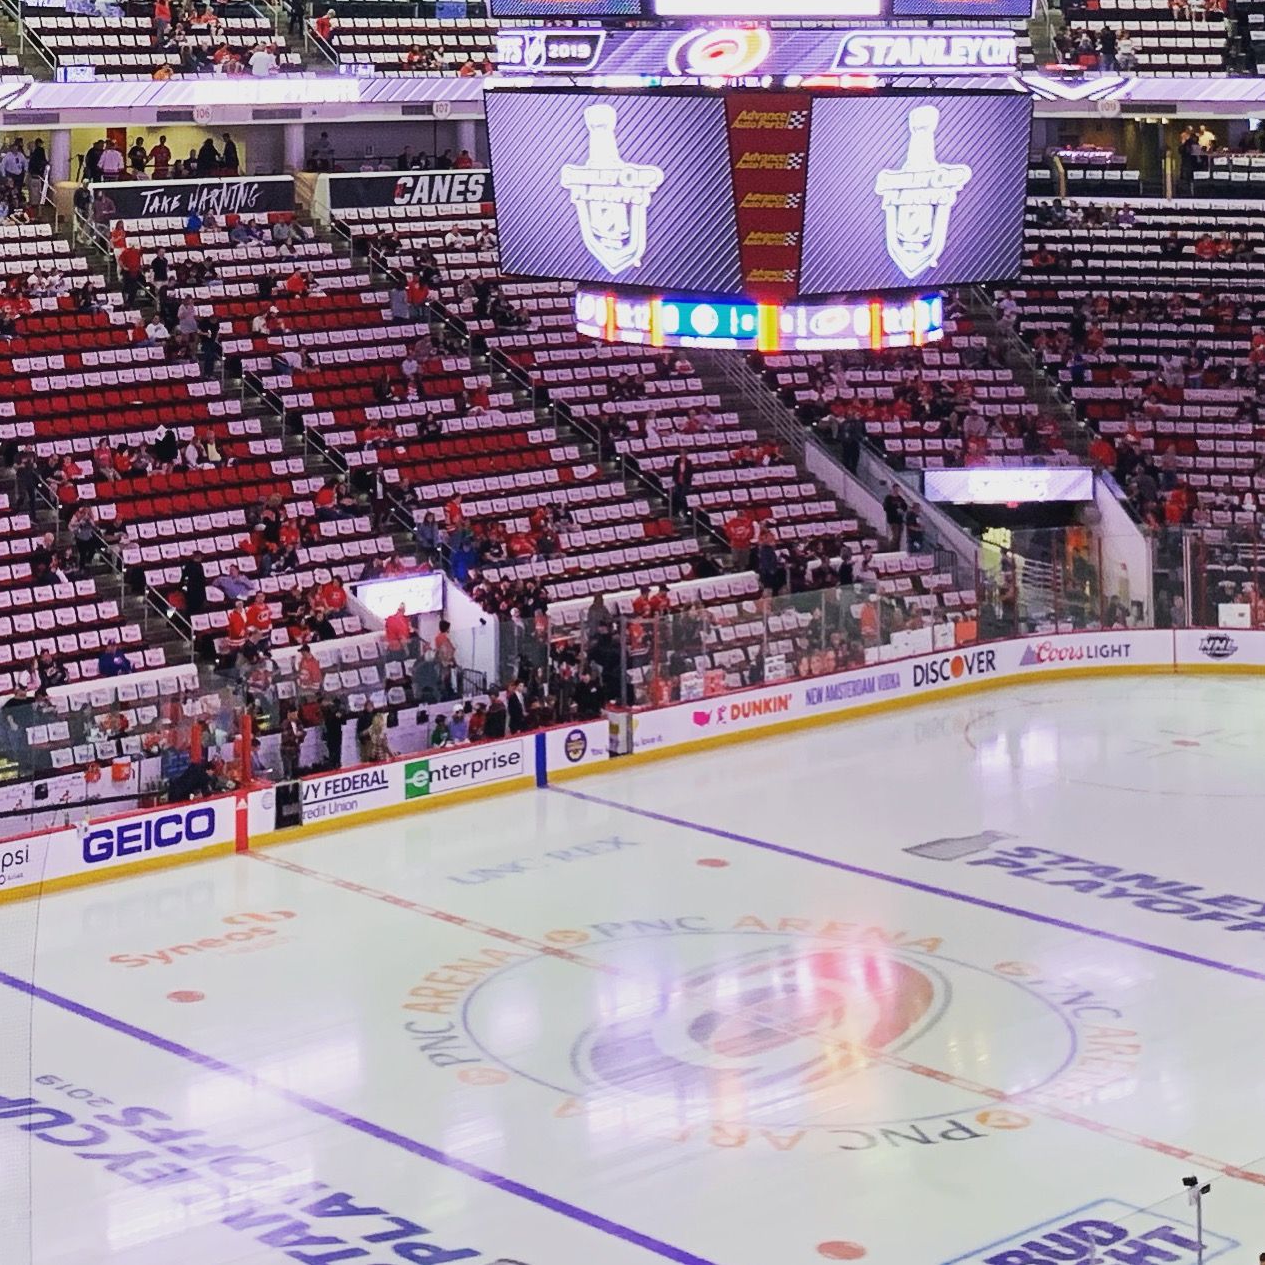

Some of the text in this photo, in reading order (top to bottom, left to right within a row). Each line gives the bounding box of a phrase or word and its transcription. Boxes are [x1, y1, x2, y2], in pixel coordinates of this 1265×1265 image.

[548, 43, 591, 59] 2019
[844, 37, 982, 67] STANLEY
[195, 108, 211, 120] 106
[435, 103, 449, 115] 107
[738, 110, 787, 121] Advance
[140, 182, 264, 217] TAKE WARNING
[394, 174, 485, 205] CANES
[1036, 641, 1131, 664] Coors LIGHT
[913, 649, 997, 688] DISCOVER
[805, 672, 901, 707] NEW AMSTERDAM VODKA
[730, 692, 793, 721] DUNKIN'
[324, 769, 389, 794] FEDERAL
[413, 749, 520, 786] enterprise
[302, 798, 358, 821] redit Union
[82, 806, 216, 864] GEICO
[592, 914, 717, 939] PNC
[109, 925, 278, 970] Syneos
[401, 945, 533, 1017] ARENA
[34, 1073, 115, 1108] 2019
[837, 1116, 988, 1152] PNC
